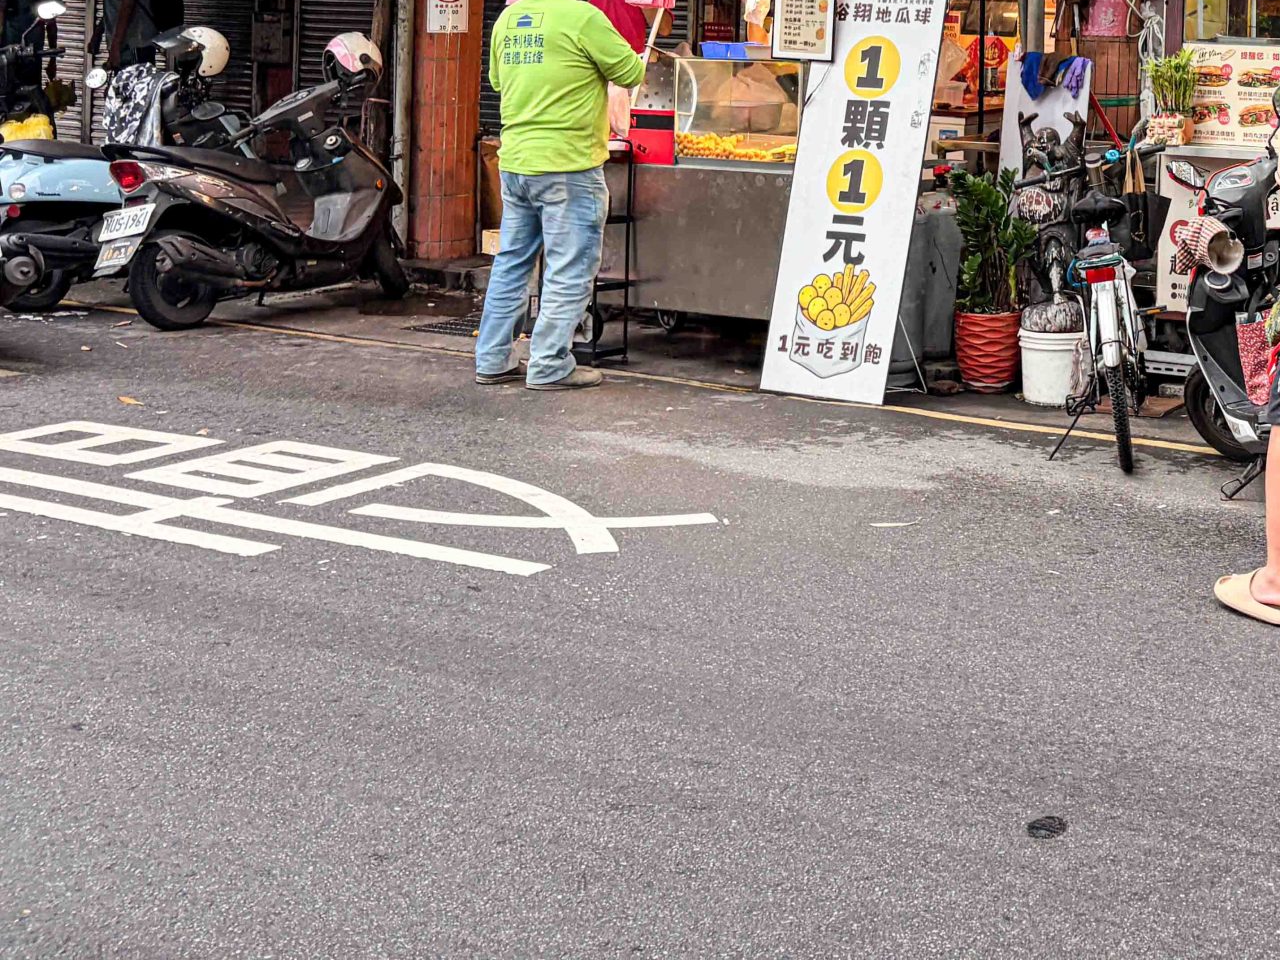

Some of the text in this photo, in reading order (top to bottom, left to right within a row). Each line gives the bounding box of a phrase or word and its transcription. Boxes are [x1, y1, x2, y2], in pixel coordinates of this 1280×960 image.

[503, 33, 544, 49] 合利模板
[777, 332, 883, 366] 1元吃到飽
